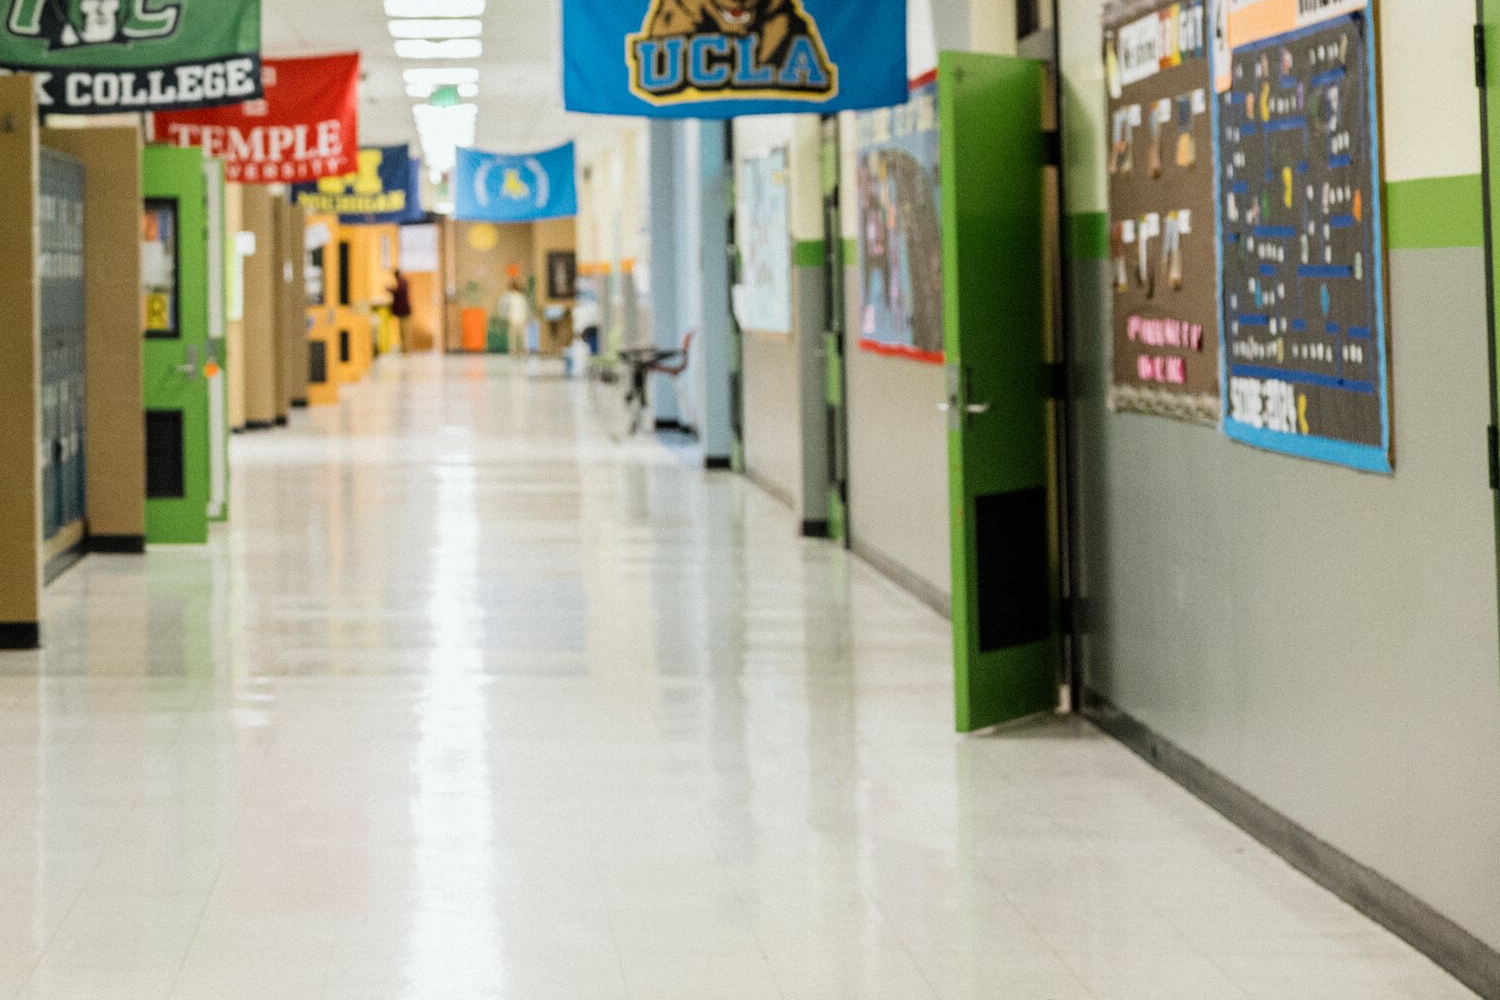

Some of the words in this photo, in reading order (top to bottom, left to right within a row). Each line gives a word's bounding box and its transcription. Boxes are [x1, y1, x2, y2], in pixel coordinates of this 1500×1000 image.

[64, 58, 256, 107] COLLEGE
[636, 32, 829, 90] UCLA
[168, 118, 344, 163] TEMPLE
